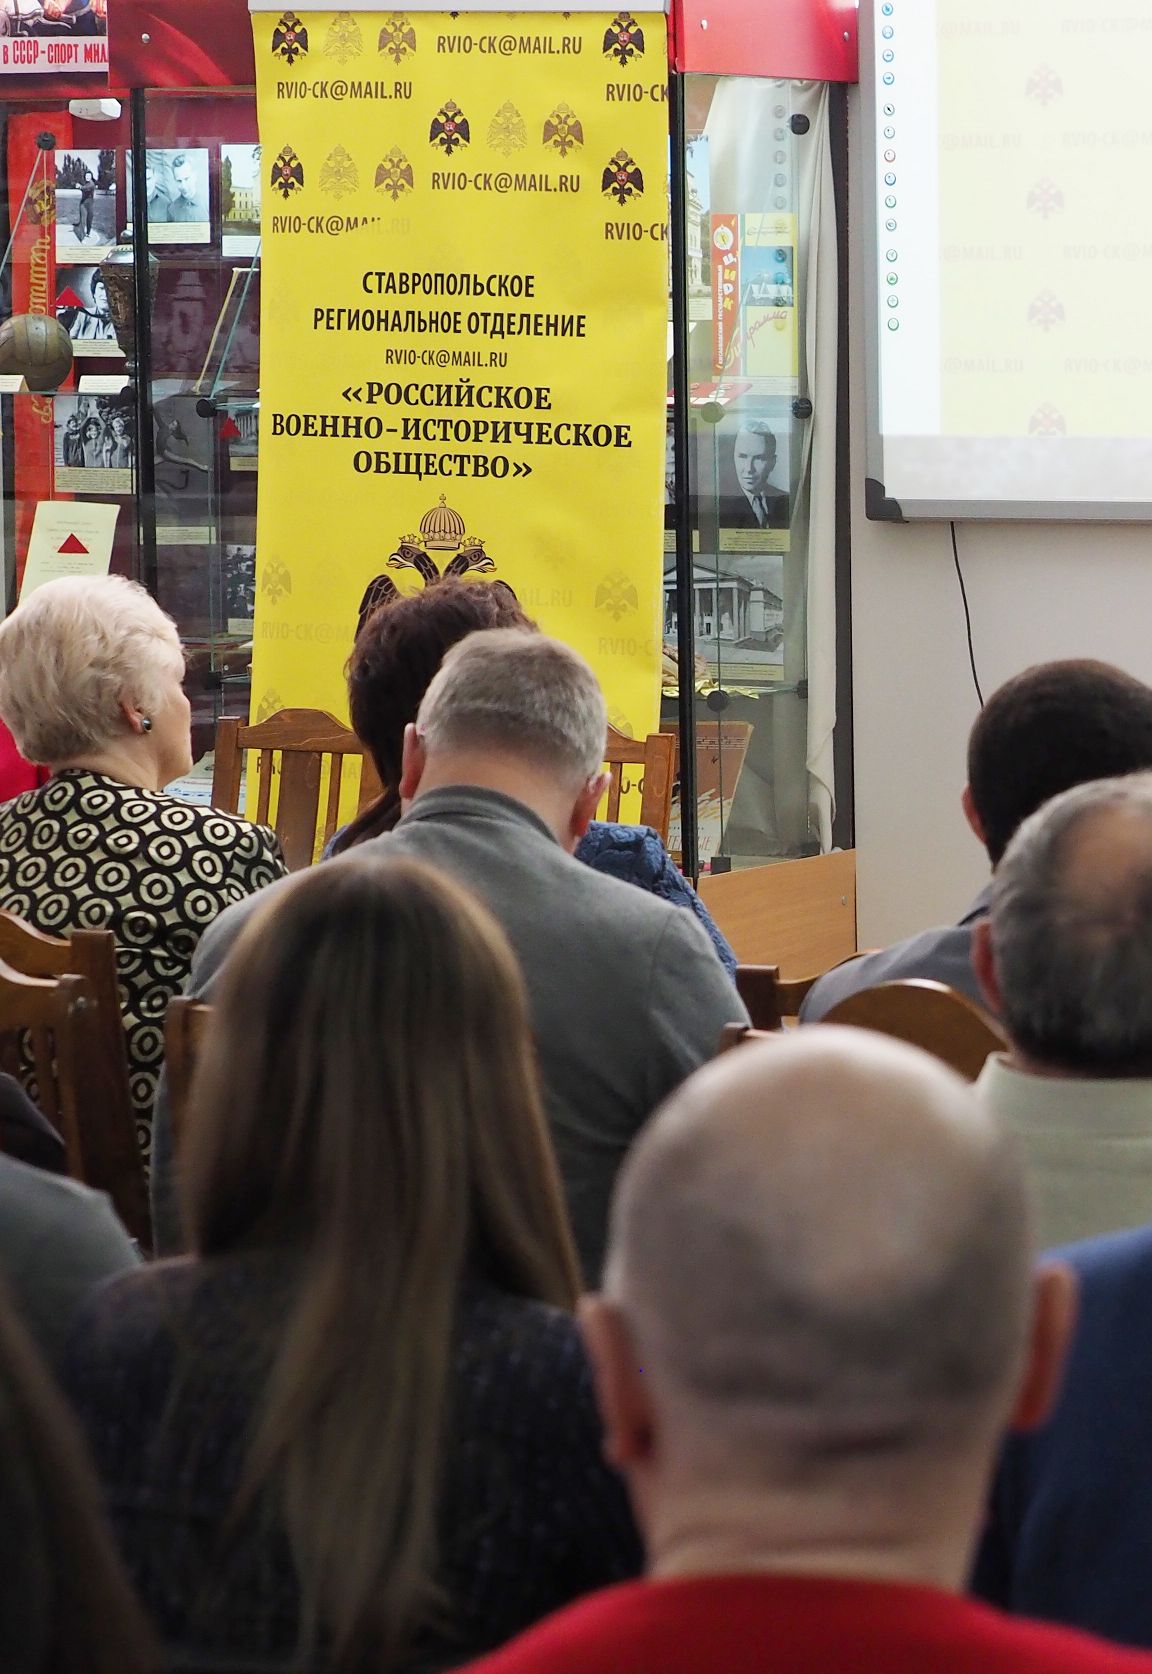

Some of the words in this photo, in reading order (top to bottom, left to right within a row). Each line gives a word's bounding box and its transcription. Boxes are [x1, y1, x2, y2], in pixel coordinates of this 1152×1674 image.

[84, 43, 108, 63] МИЛ
[437, 35, 582, 55] RVIO-CK@MAIL.RU
[277, 80, 412, 100] RVIO-CK@MAIL.RU
[431, 172, 580, 193] RVIO-CK@MAIL.RU
[362, 271, 535, 297] СТАВРОПОЛЬСКОЕ
[313, 308, 462, 334] РЕГИОНАЛЬНОЕ
[467, 311, 586, 339] ОТДЕЛЕНИЕ
[385, 349, 508, 368] RVIO-CK@MAIL.RU
[342, 377, 552, 410] «РОССИЙСКОЕ
[271, 413, 633, 448] ВОЕННО-ИСТОРИЧЕСКОЕ
[352, 450, 533, 482] ОБЩЕСТВО»
